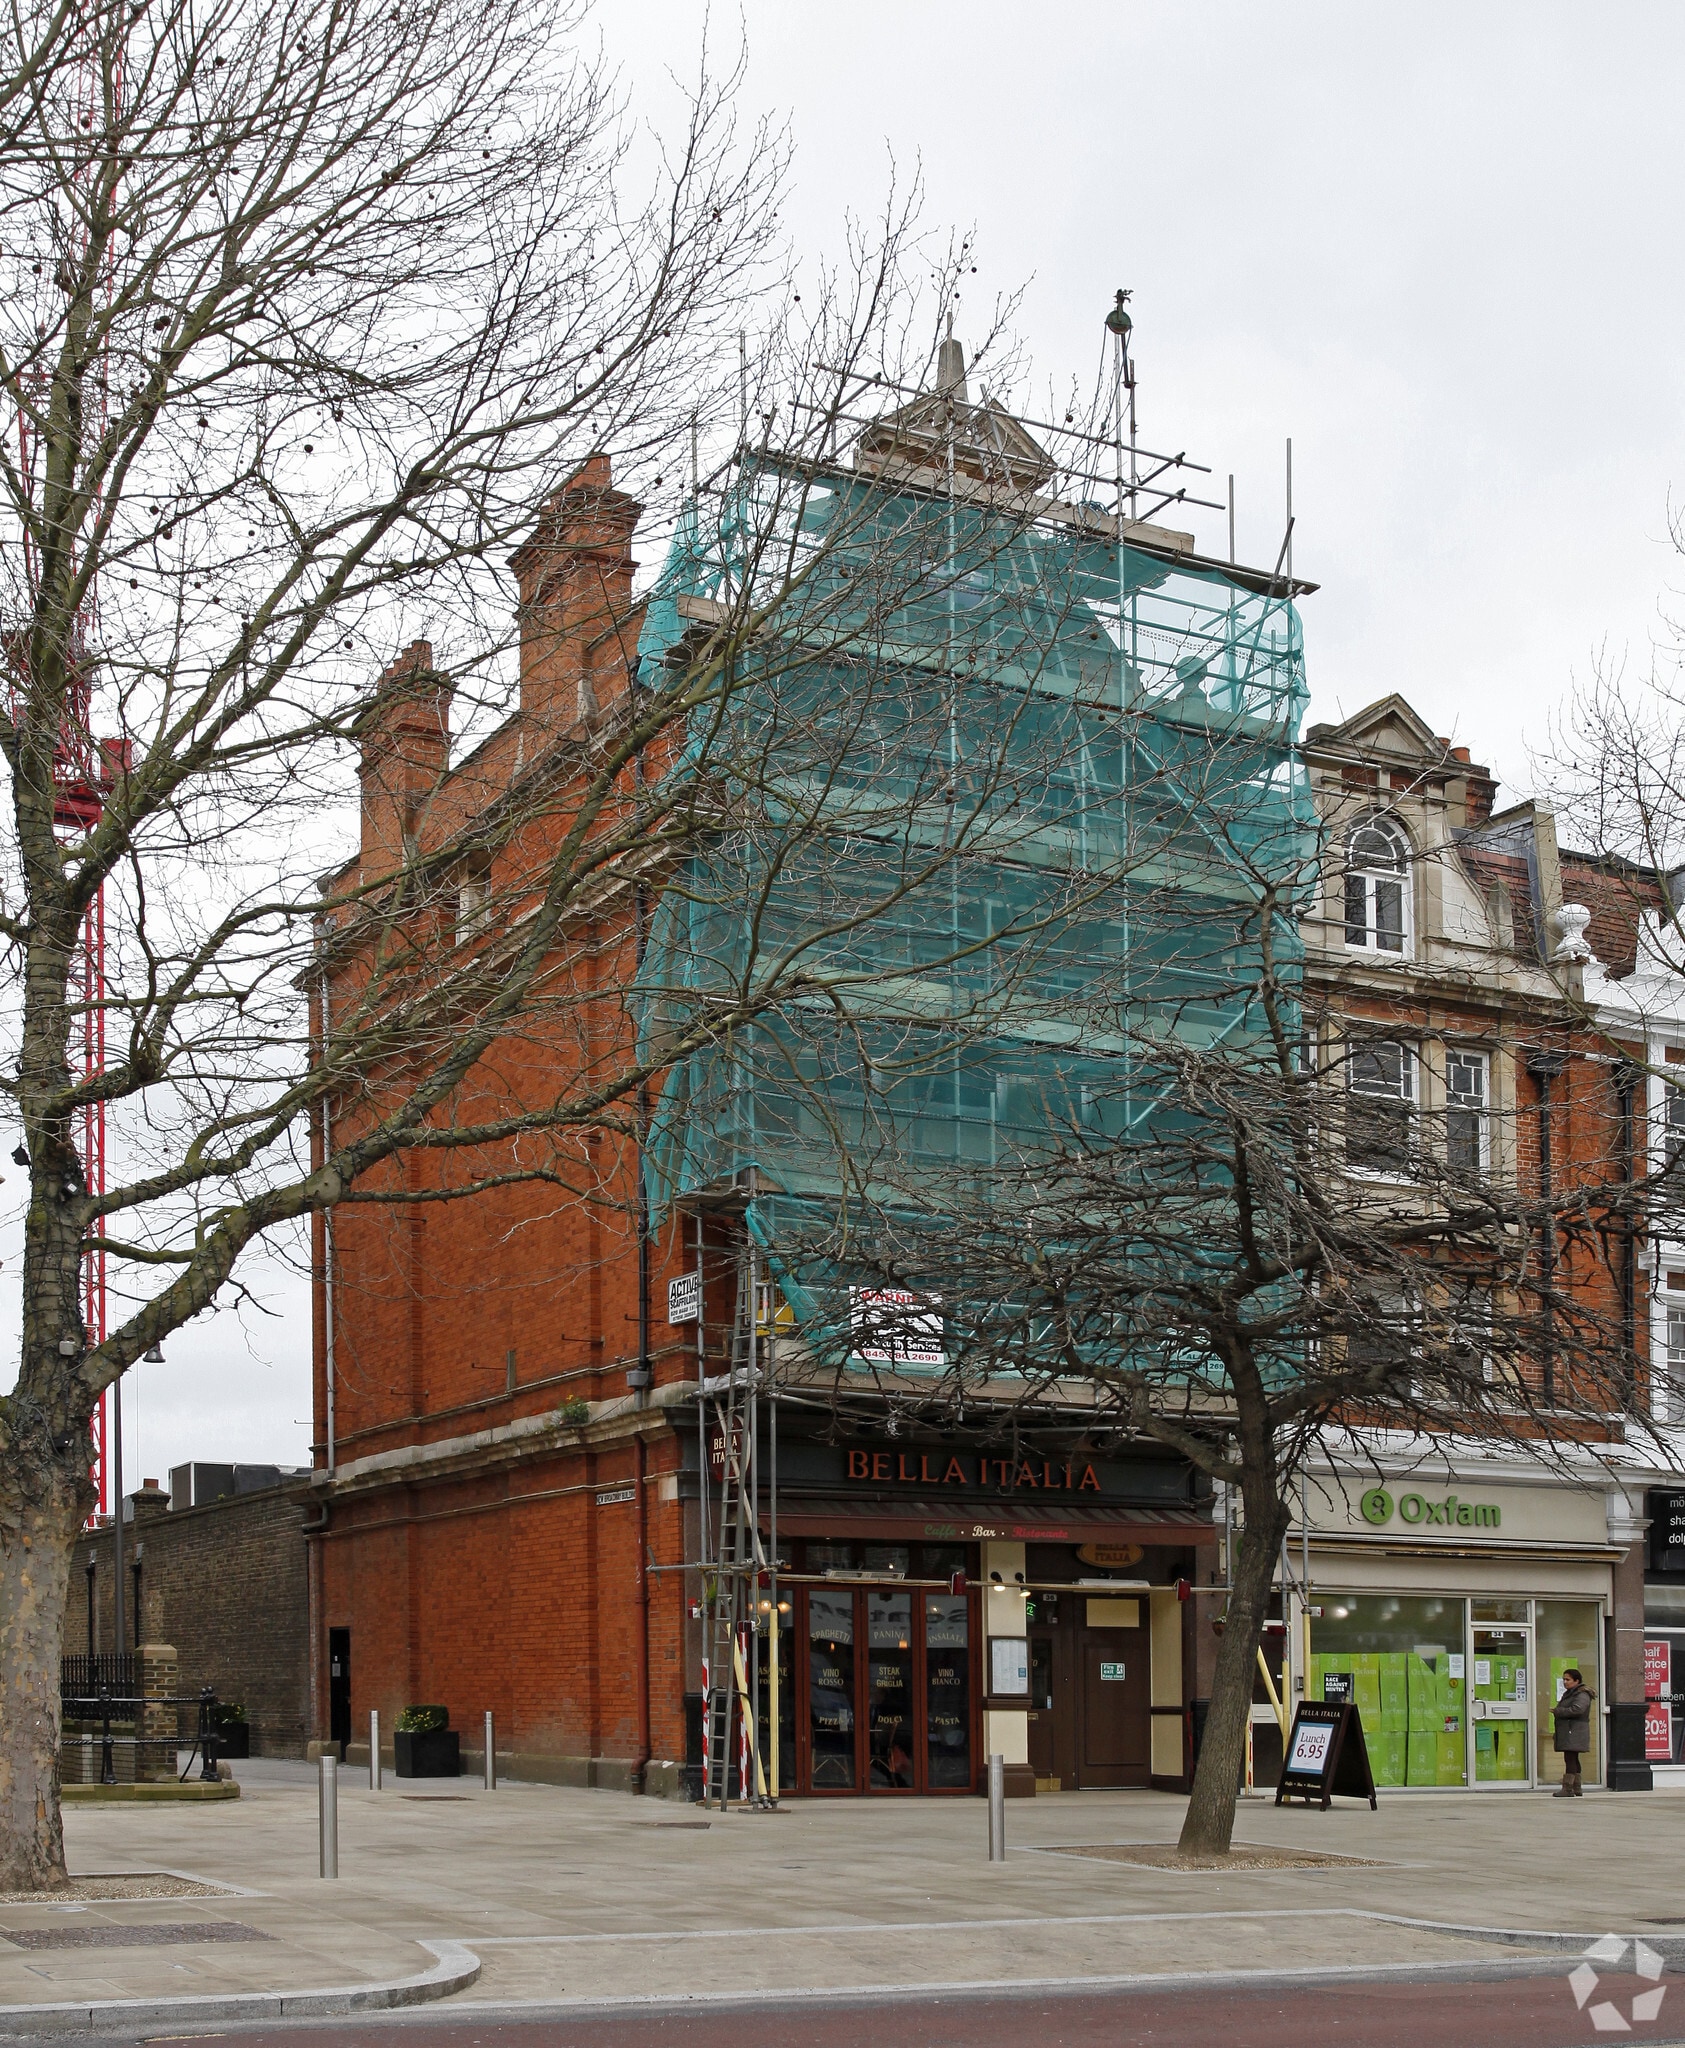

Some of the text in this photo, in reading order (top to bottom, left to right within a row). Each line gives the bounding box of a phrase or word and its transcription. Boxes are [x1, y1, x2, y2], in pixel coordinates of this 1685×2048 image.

[907, 1341, 941, 1351] Services
[912, 1353, 938, 1361] 2690
[713, 1435, 738, 1450] BELA
[848, 1450, 1101, 1491] BELLA ITALIA
[1400, 1493, 1501, 1527] Oxfam
[972, 1525, 996, 1537] Bar
[1012, 1526, 1068, 1539] Ristorante
[810, 1629, 850, 1643] SPAGHETTI
[874, 1630, 905, 1640] PANINI
[928, 1632, 964, 1645] INSALATA
[823, 1668, 840, 1677] VINO
[879, 1666, 900, 1676] STEAK
[938, 1668, 954, 1677] VINO
[876, 1679, 903, 1688] GRIGLIA
[932, 1677, 960, 1686] BIANCO
[1320, 1710, 1341, 1718] ITALIA
[877, 1715, 903, 1724] DOLCI
[934, 1716, 961, 1726] PASTA
[1301, 1732, 1326, 1744] Lunch
[1297, 1744, 1324, 1759] 6.95
